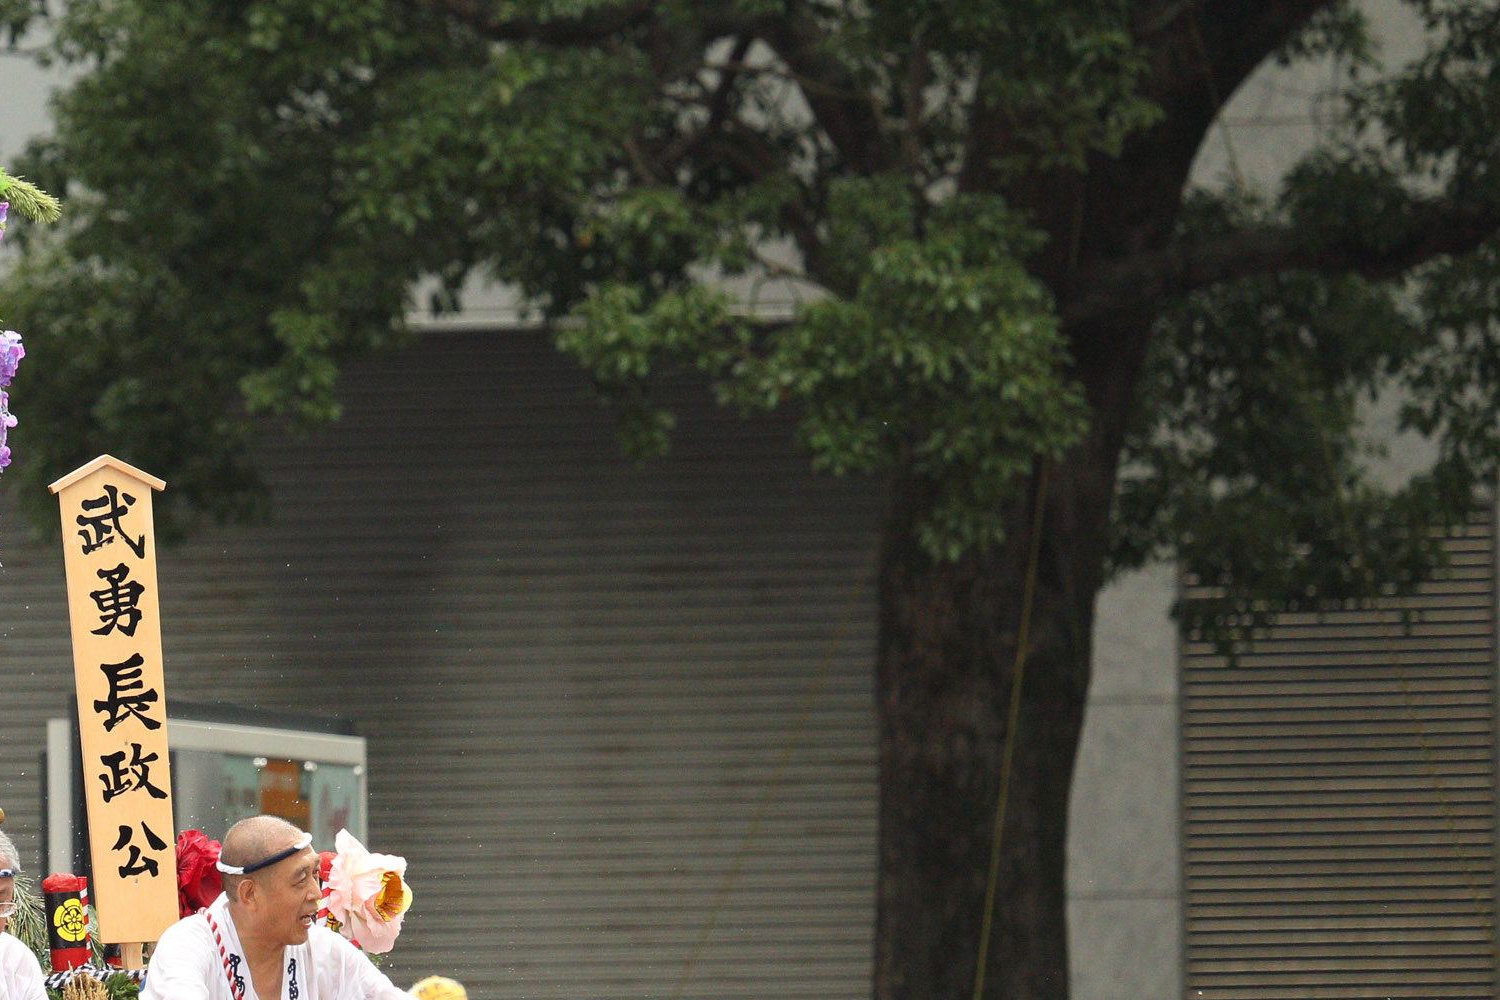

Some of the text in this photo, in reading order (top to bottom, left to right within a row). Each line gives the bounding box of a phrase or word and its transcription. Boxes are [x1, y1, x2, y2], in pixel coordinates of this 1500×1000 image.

[76, 484, 168, 879] 武勇長政公
